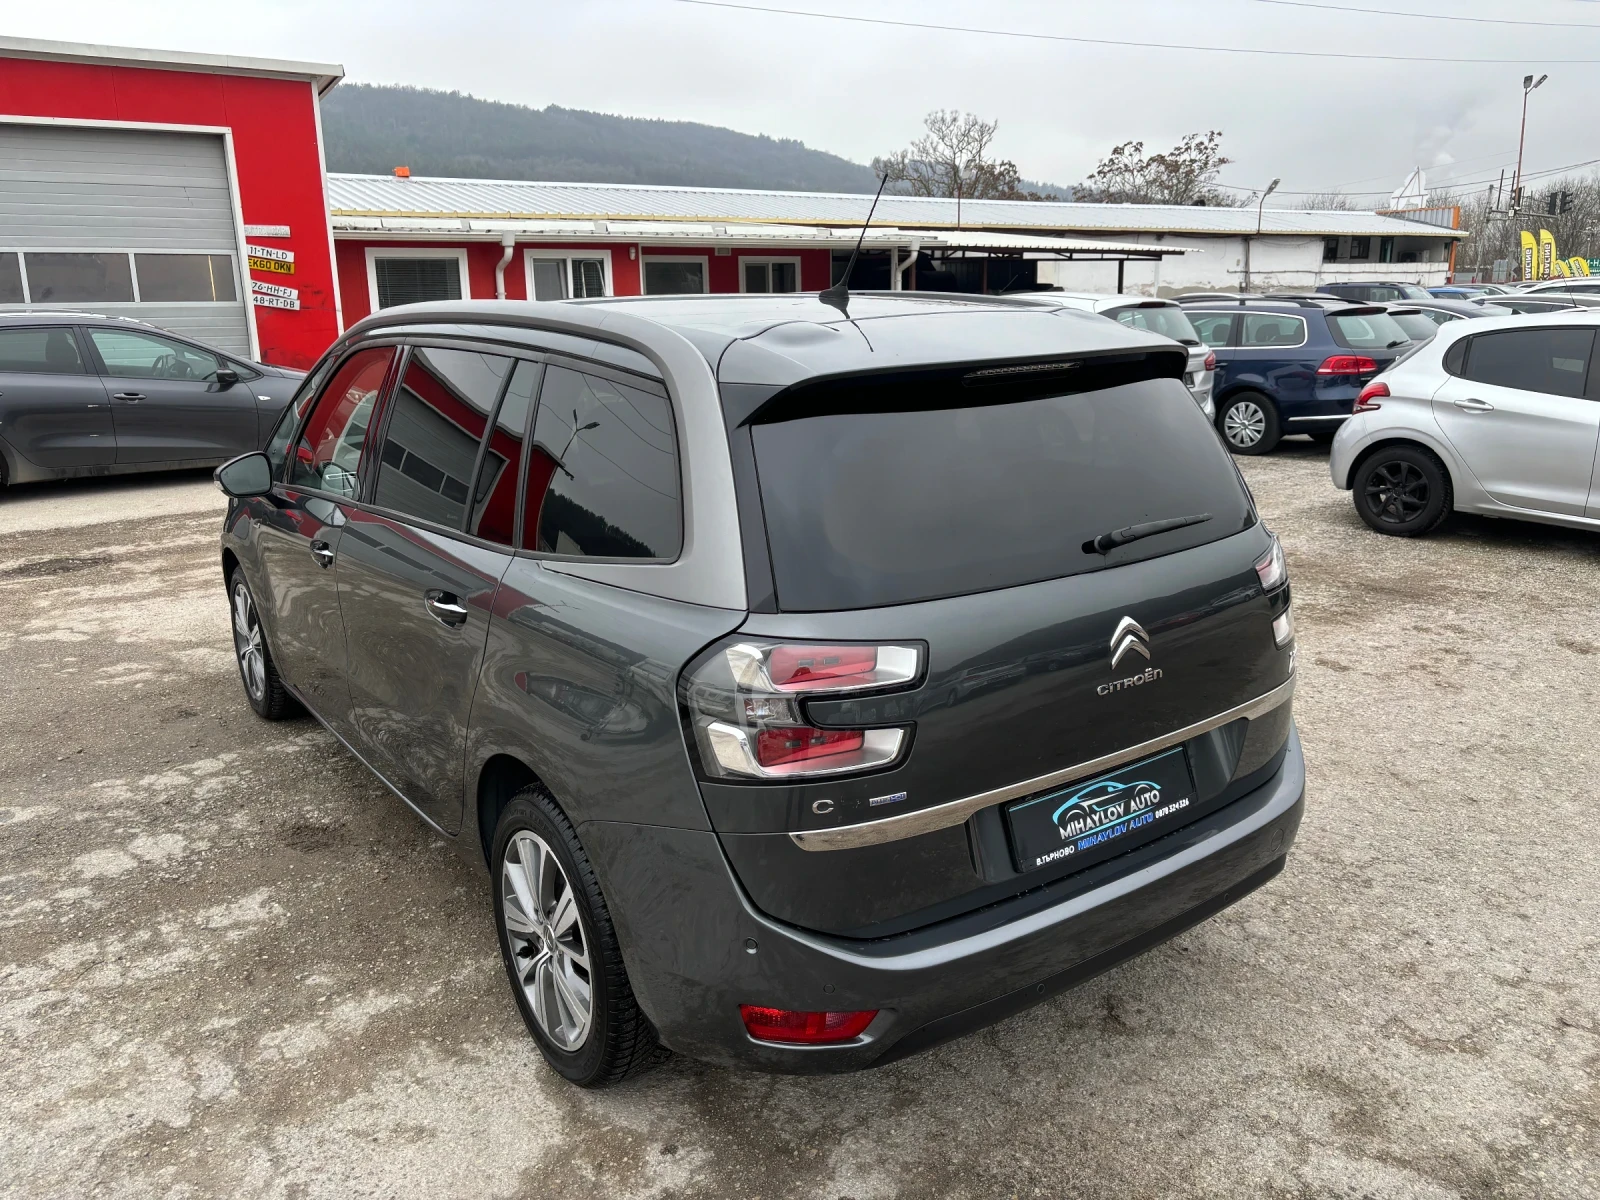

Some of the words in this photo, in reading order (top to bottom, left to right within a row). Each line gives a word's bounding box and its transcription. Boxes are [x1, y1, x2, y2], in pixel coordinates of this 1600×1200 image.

[249, 246, 288, 260] 11-TN-LD
[252, 281, 293, 298] 76-HH-FJ
[253, 295, 295, 308] 48-RT-DB
[1058, 804, 1125, 840] MIHAYLOV
[1129, 789, 1160, 814] AUTO
[1077, 823, 1128, 851] MIHAYLOV
[1129, 812, 1154, 831] AUTO
